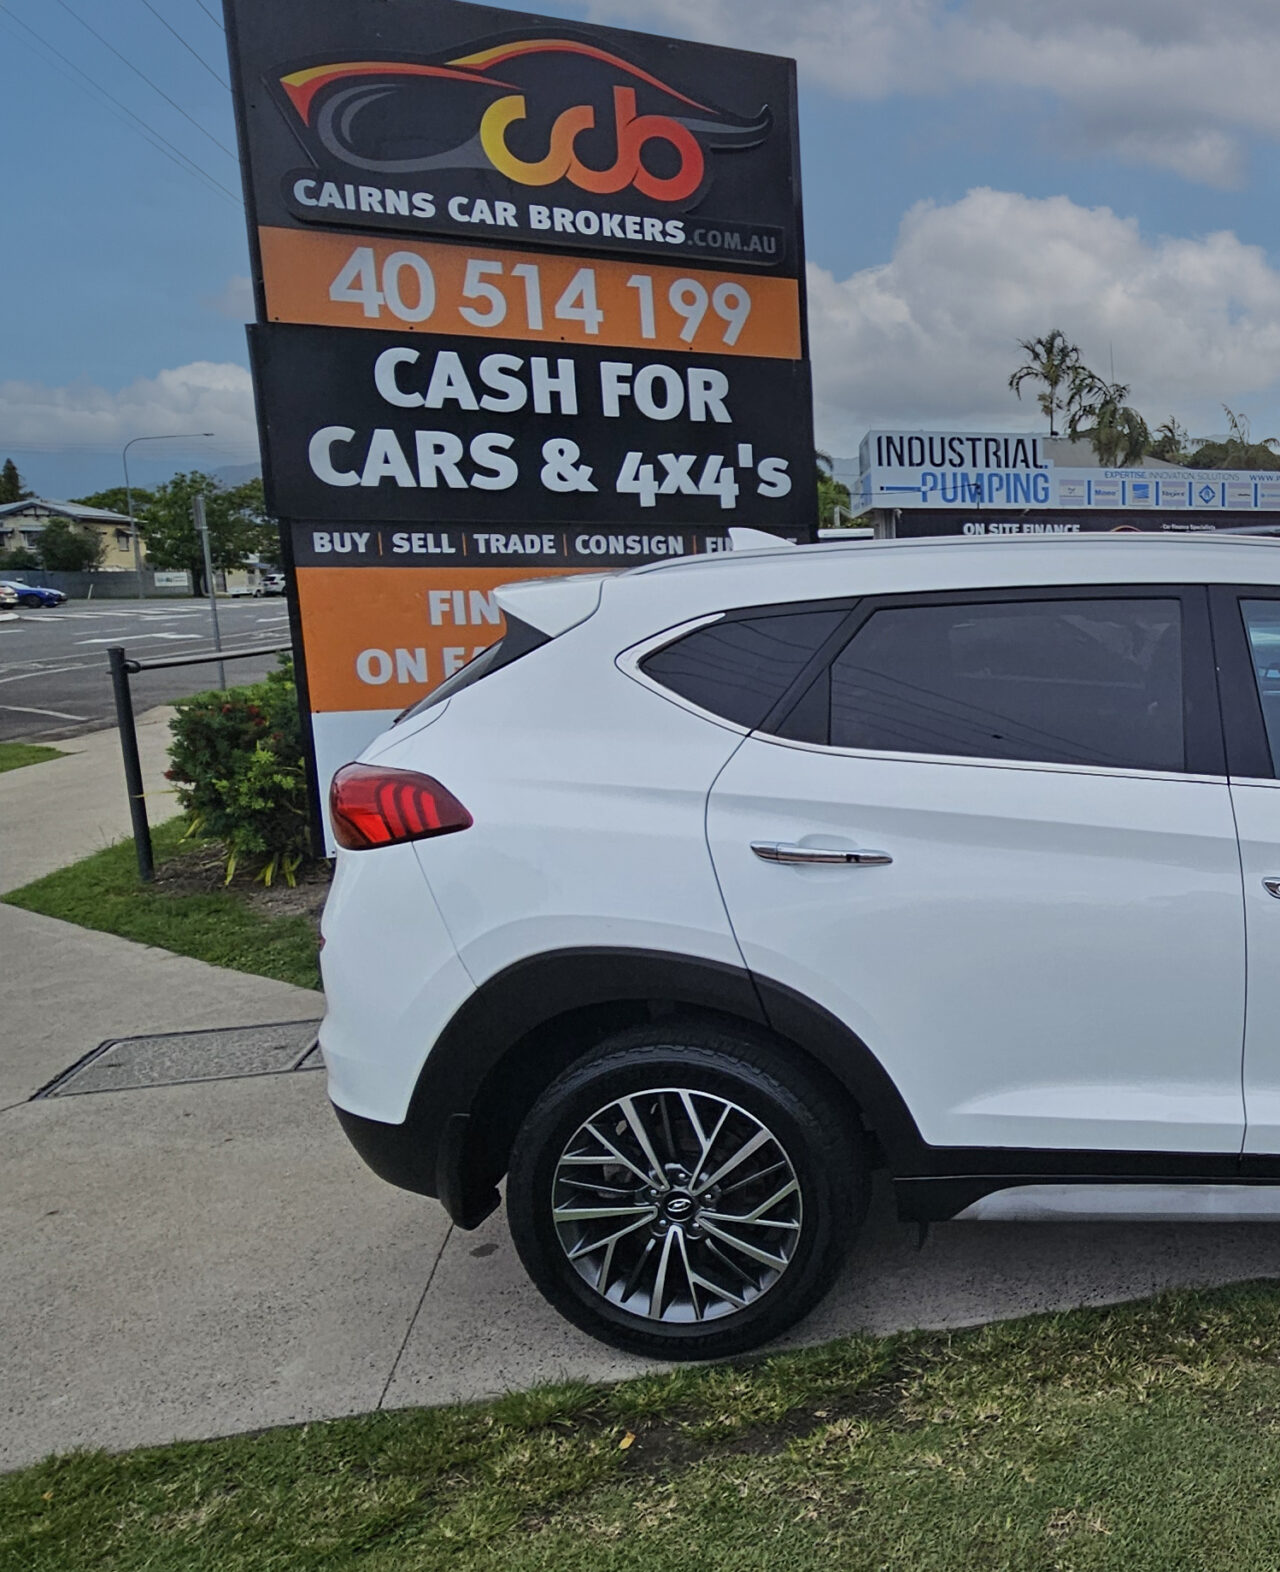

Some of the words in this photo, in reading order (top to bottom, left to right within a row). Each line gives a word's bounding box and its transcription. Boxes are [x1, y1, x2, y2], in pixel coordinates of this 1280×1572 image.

[293, 178, 437, 218] CAIRNS
[448, 196, 518, 227] CAR
[329, 247, 436, 323] 40
[458, 259, 603, 335] 514
[627, 274, 752, 347] 199
[374, 347, 579, 415] CASH
[600, 361, 733, 424] FOR
[308, 426, 519, 491] CARS
[541, 438, 598, 493] &
[921, 471, 1050, 503] PUMPING
[312, 531, 371, 554] BUY
[392, 532, 455, 554] SELL
[473, 533, 557, 555] TRADE
[575, 534, 684, 555] CONSIGN
[963, 523, 985, 535] ON
[989, 523, 1019, 535] SITE
[1023, 524, 1081, 534] FINANCE
[428, 590, 501, 626] FIN
[356, 647, 429, 685] ON
